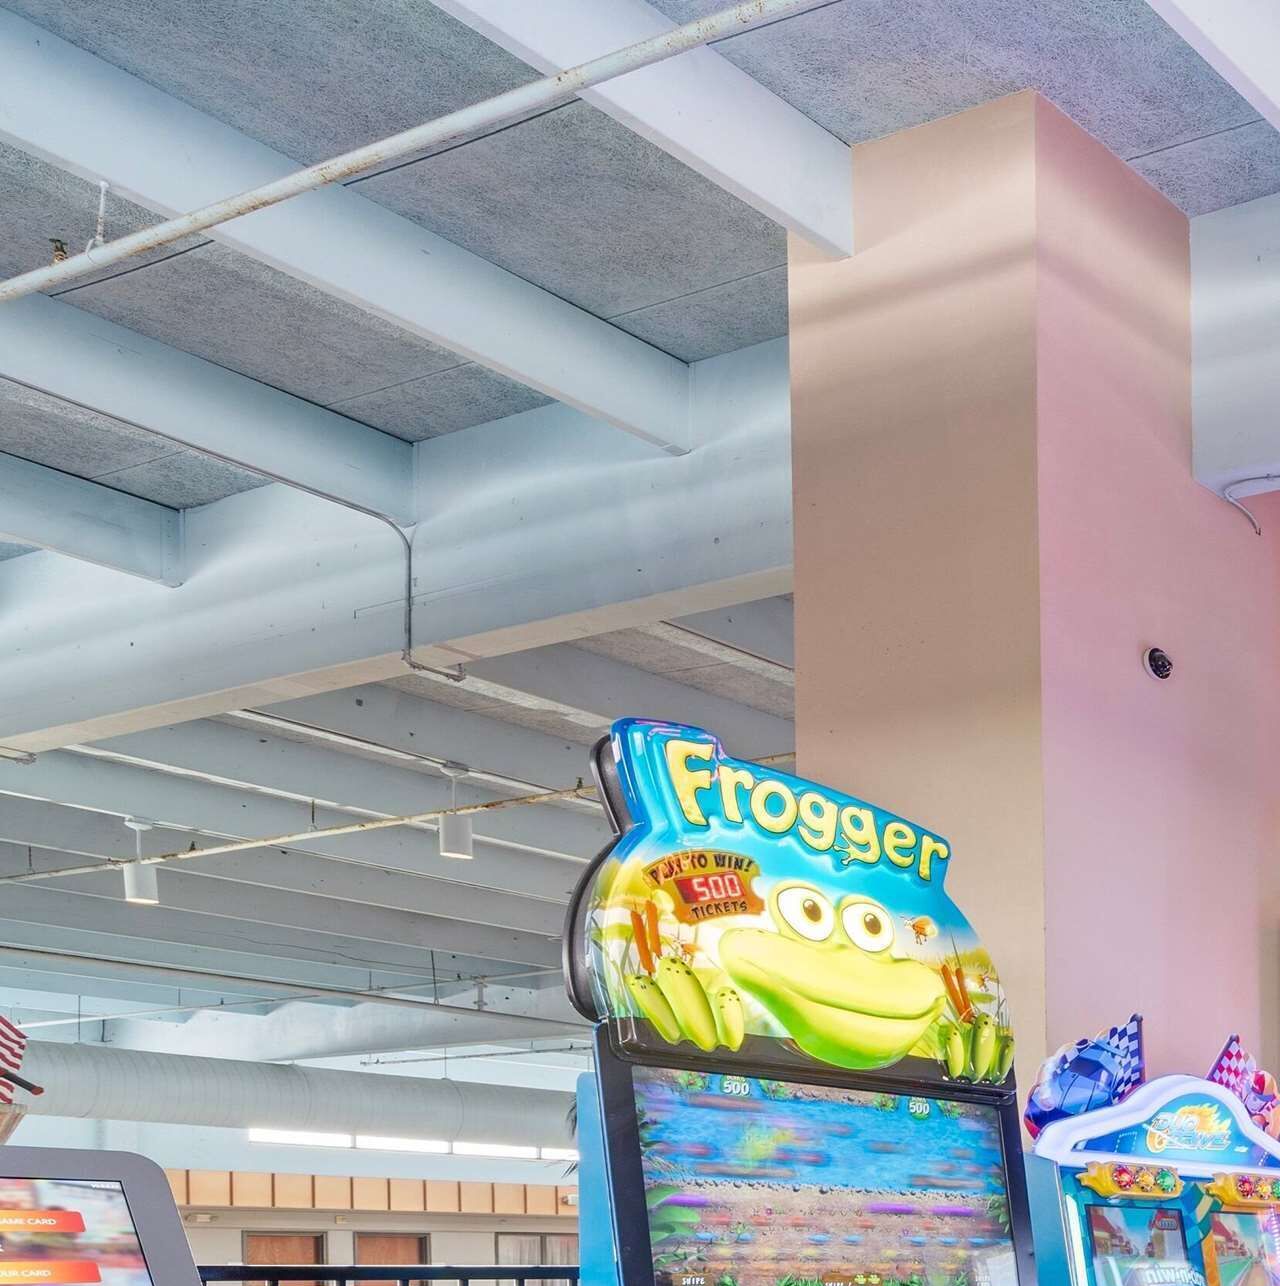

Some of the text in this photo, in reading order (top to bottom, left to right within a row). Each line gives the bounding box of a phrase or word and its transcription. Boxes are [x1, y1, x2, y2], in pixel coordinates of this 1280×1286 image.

[665, 738, 950, 882] Frogger
[691, 854, 707, 869] TO
[714, 853, 754, 873] WIN!
[690, 874, 741, 901] 500
[691, 901, 748, 921] TICKETS
[723, 1078, 750, 1096] 500
[909, 1101, 930, 1114] 500
[27, 1218, 57, 1226] CARD
